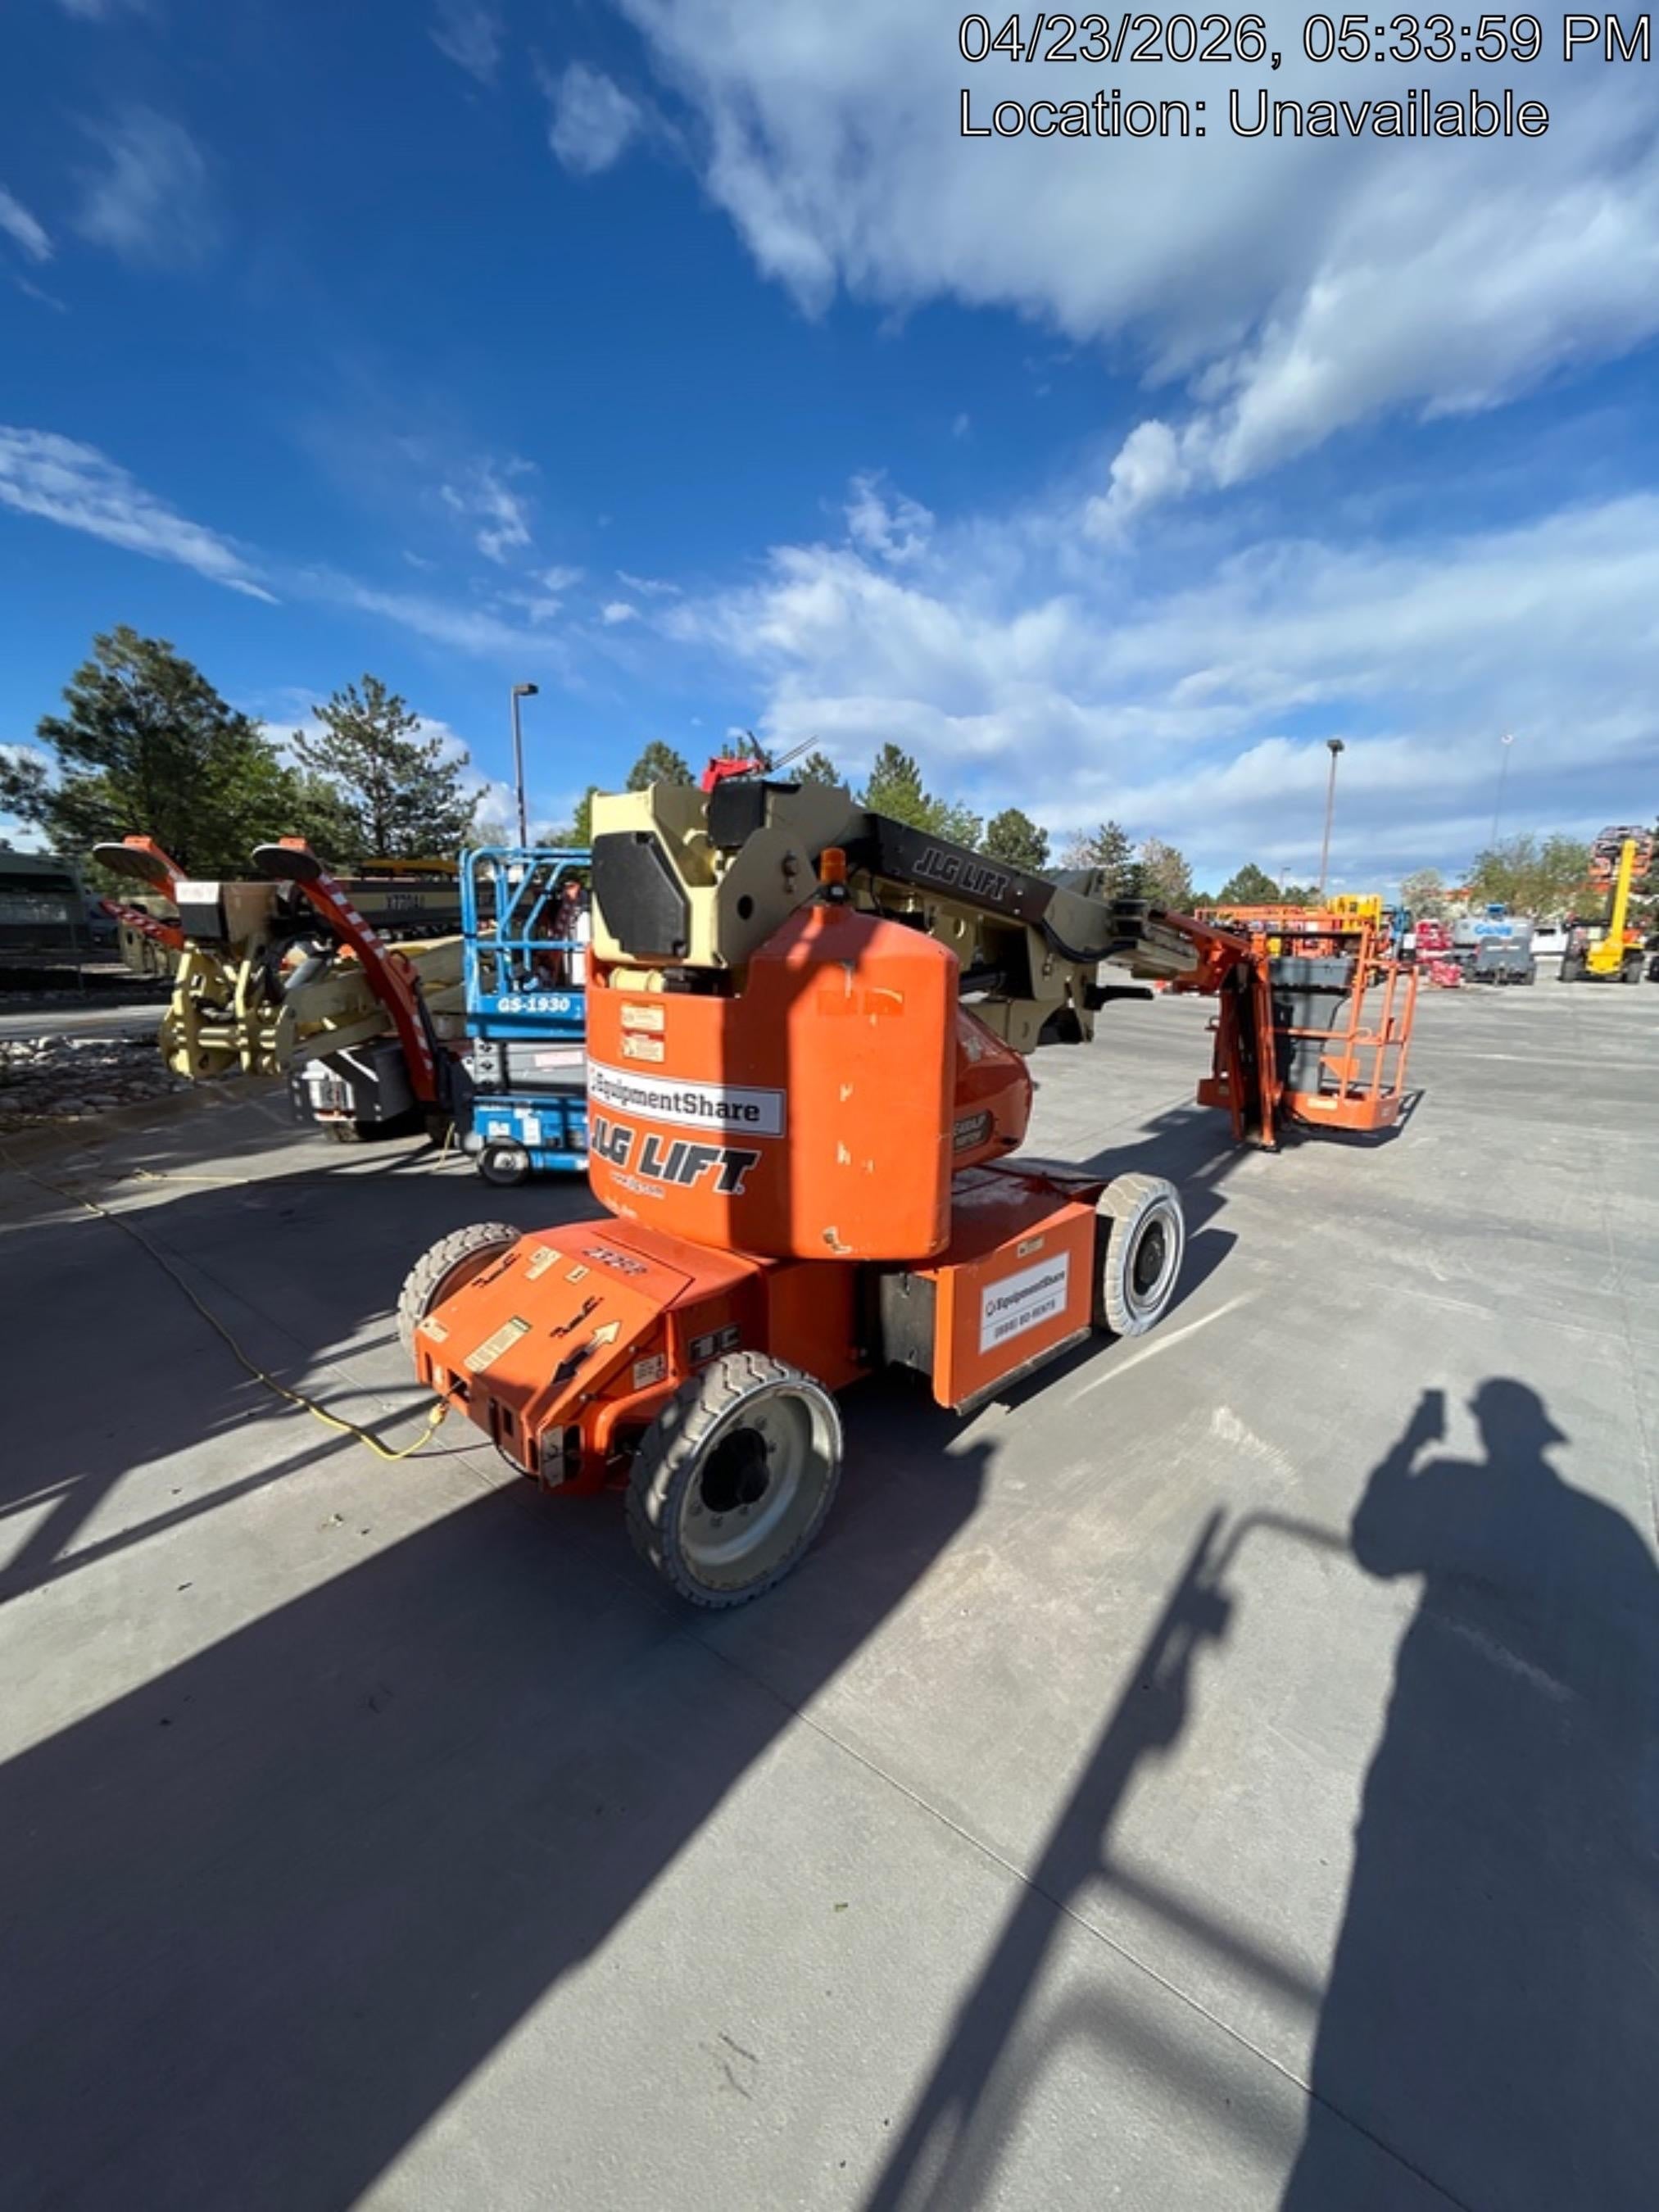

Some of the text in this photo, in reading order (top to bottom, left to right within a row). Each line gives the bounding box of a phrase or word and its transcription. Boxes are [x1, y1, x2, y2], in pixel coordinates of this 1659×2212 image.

[912, 847, 1011, 901] JLG LIFT
[496, 996, 572, 1013] GS-1930
[595, 1071, 761, 1122] EquipmentShare
[590, 1117, 761, 1194] JLG LIFT
